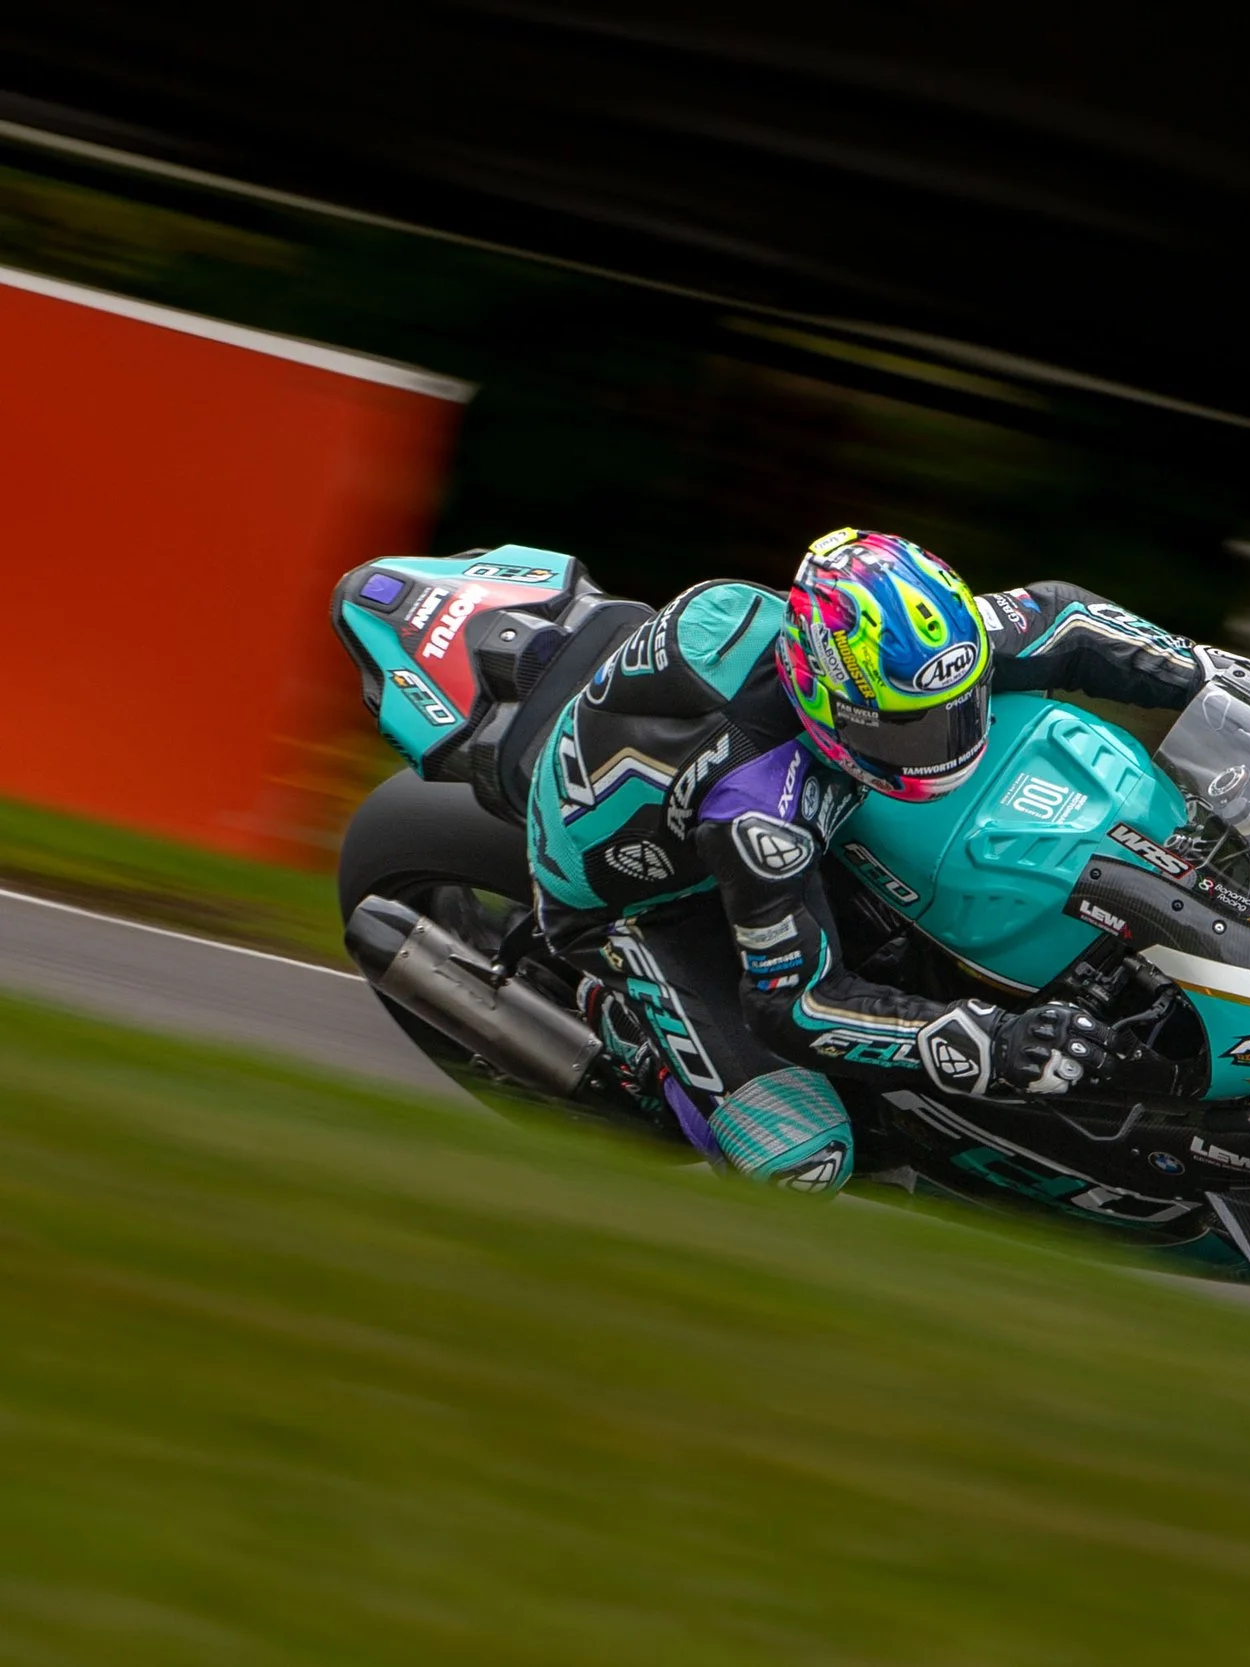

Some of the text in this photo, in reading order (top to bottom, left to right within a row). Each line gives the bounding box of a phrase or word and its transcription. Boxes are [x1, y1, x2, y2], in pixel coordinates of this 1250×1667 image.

[411, 587, 449, 629] LEW
[422, 584, 490, 659] MOTUL
[923, 647, 972, 688] Arai
[667, 733, 730, 840] IXON
[778, 749, 801, 818] IXON
[902, 761, 957, 776] TAMWORTH
[1110, 825, 1189, 874] WRS
[1080, 900, 1126, 931] LEW
[1217, 894, 1247, 912] Racing
